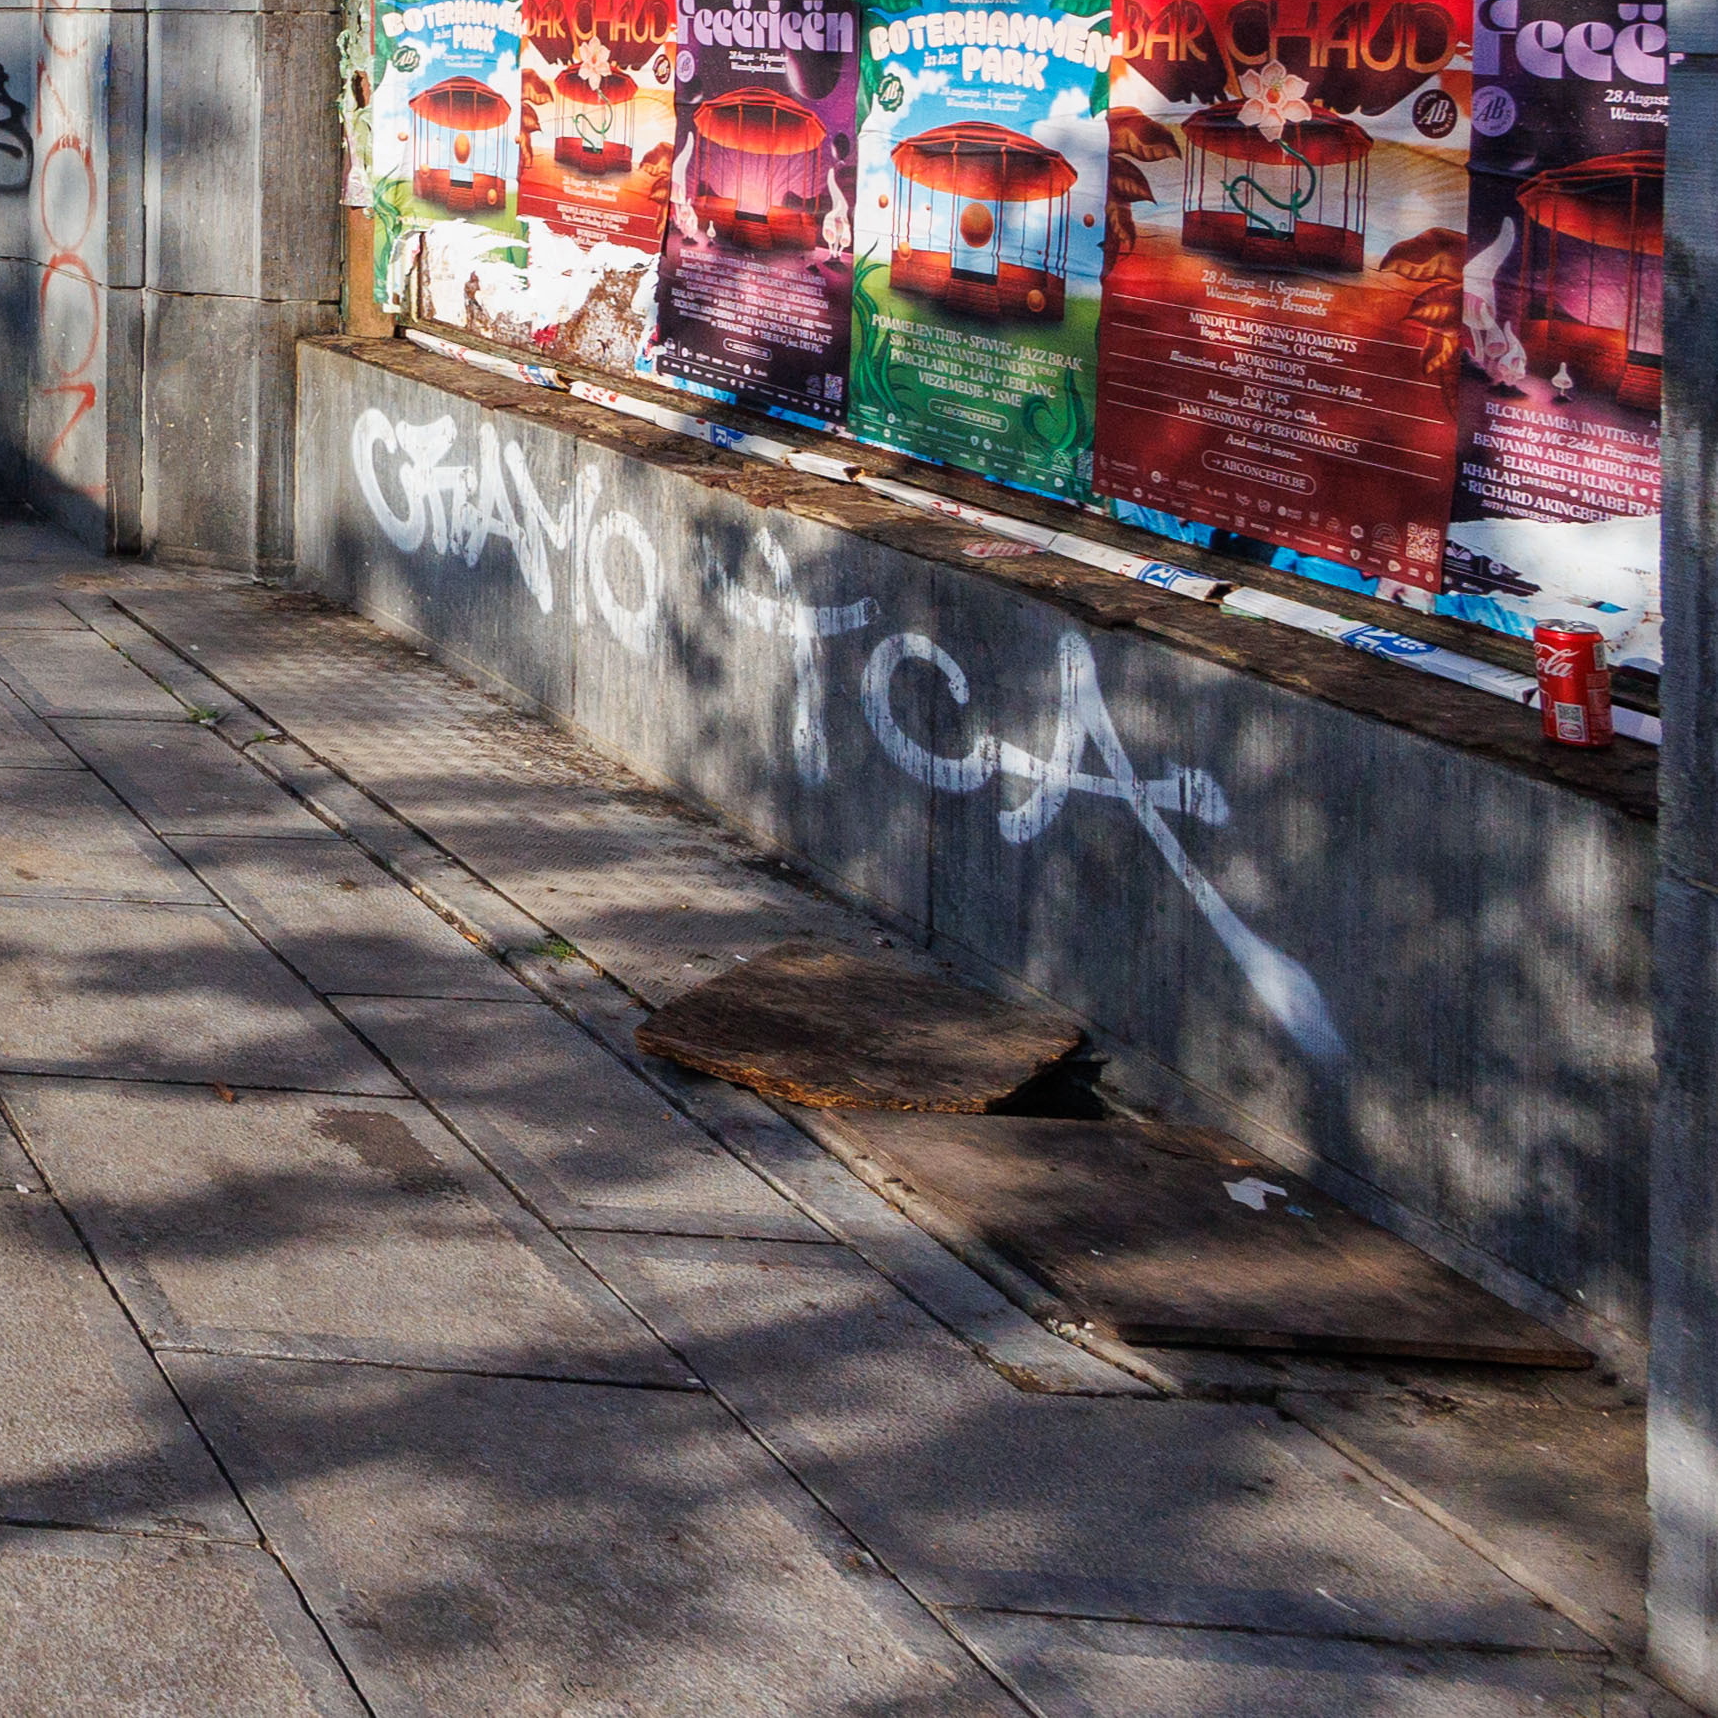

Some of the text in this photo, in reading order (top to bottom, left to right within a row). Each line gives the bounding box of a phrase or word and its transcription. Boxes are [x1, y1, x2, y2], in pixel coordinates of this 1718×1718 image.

[453, 26, 496, 52] PARK
[868, 11, 1120, 73] BOTERHAMMEN
[1225, 0, 1457, 73] CHAUD
[924, 47, 1050, 90] in het PARK
[1604, 89, 1623, 103] 28
[1201, 269, 1217, 283] 28
[1241, 320, 1294, 342] MORNING
[1296, 329, 1356, 354] MOMENTS
[1019, 346, 1047, 365] JAZZ
[1049, 352, 1082, 371] BRAK
[1234, 350, 1306, 377] WORKSHOPS
[1178, 401, 1358, 454] JAM SESSIONS PERFORMANCES
[1486, 401, 1641, 446] BLCK MAMBA INVITES:
[1544, 430, 1566, 446] MC
[1473, 432, 1582, 467] BENJAMIN ABEL
[1223, 458, 1305, 489] ABCONCERTS.BE
[1464, 463, 1624, 511] KHALAB MABE
[1503, 455, 1635, 496] ELISABETH KLINCK
[1468, 479, 1532, 506] RICHARD
